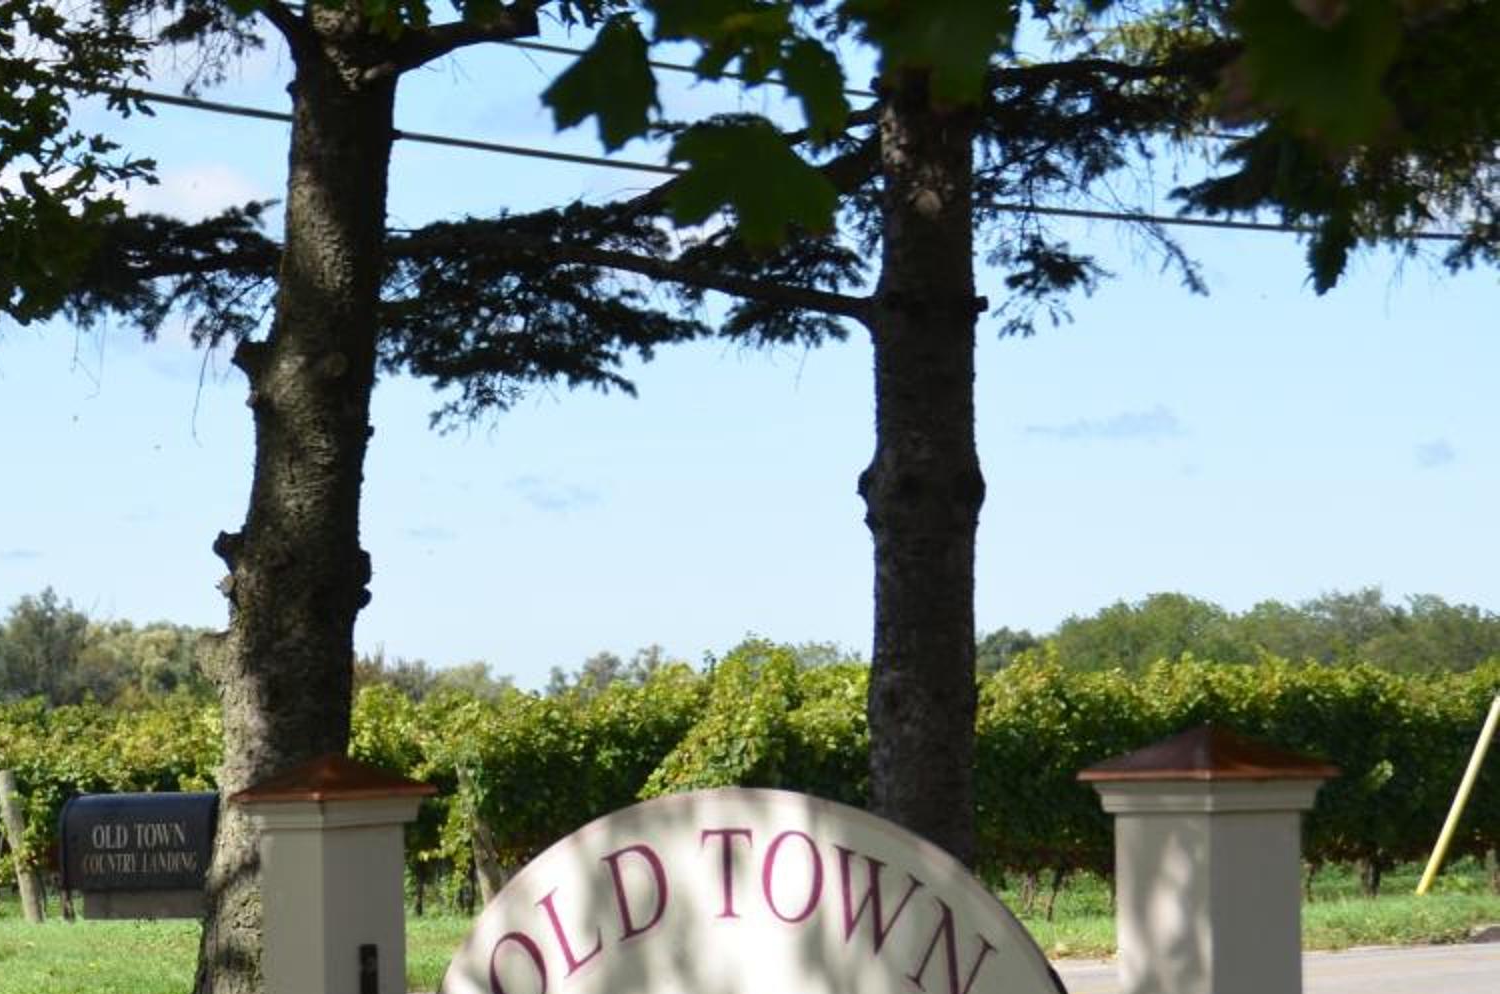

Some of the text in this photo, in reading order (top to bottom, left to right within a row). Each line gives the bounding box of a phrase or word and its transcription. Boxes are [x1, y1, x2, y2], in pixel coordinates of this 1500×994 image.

[92, 823, 186, 849] OLD TOWN
[83, 851, 197, 873] COUNTRY LANDING
